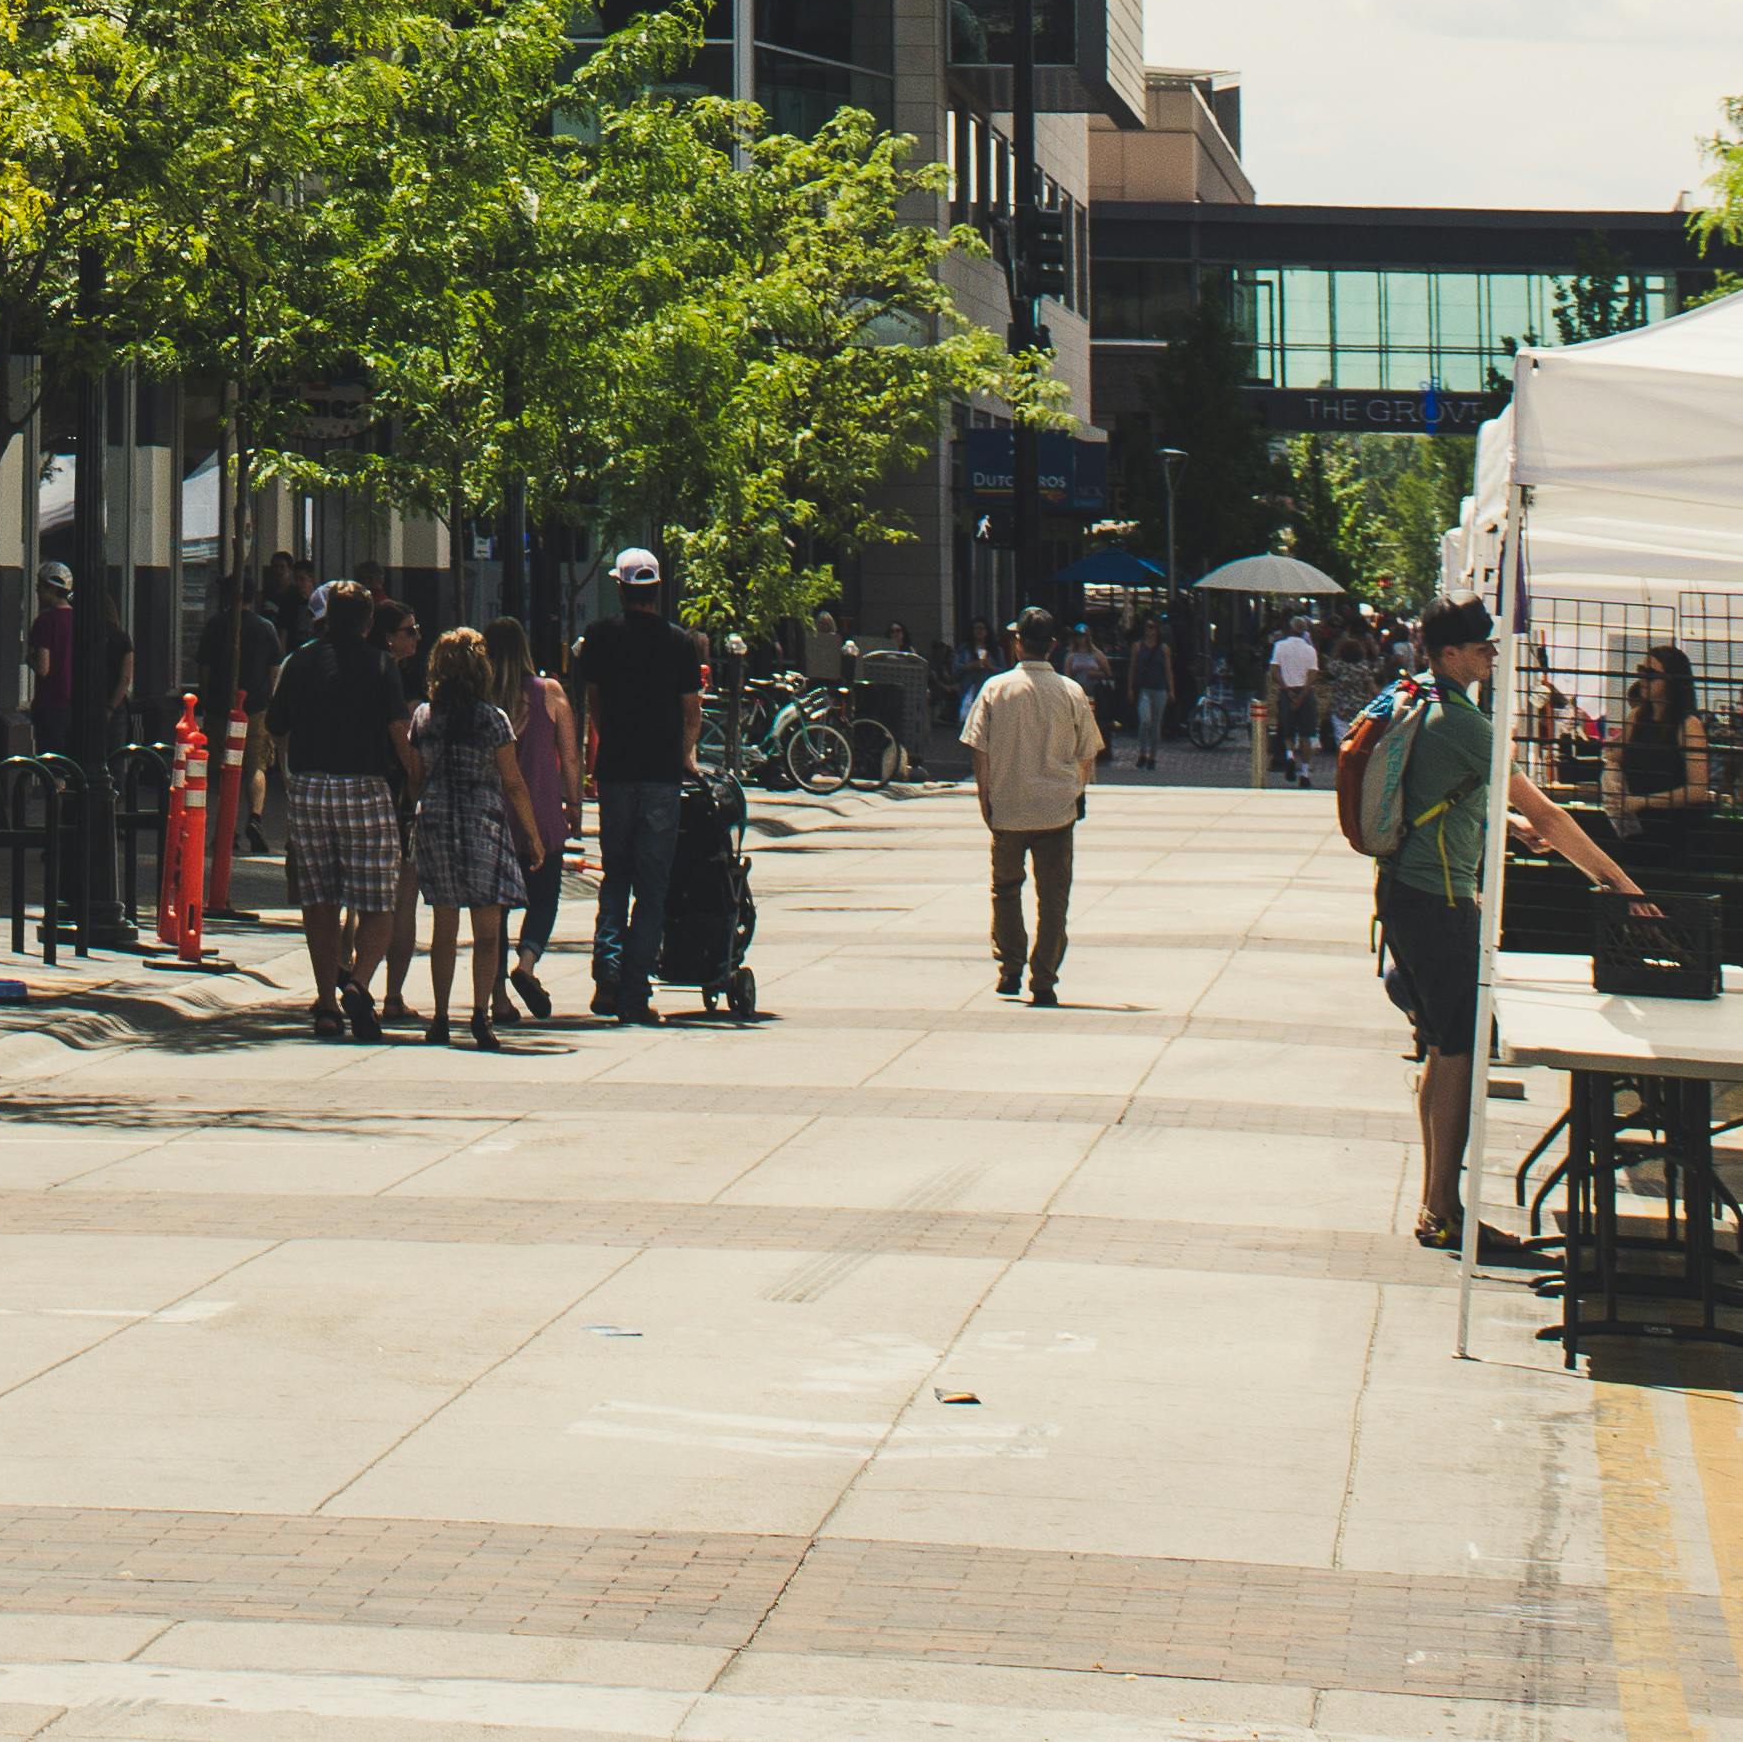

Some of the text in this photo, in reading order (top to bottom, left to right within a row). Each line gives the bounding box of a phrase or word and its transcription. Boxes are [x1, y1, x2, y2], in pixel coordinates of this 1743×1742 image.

[1305, 397, 1358, 421] THE
[973, 472, 1067, 489] DUTC ROS
